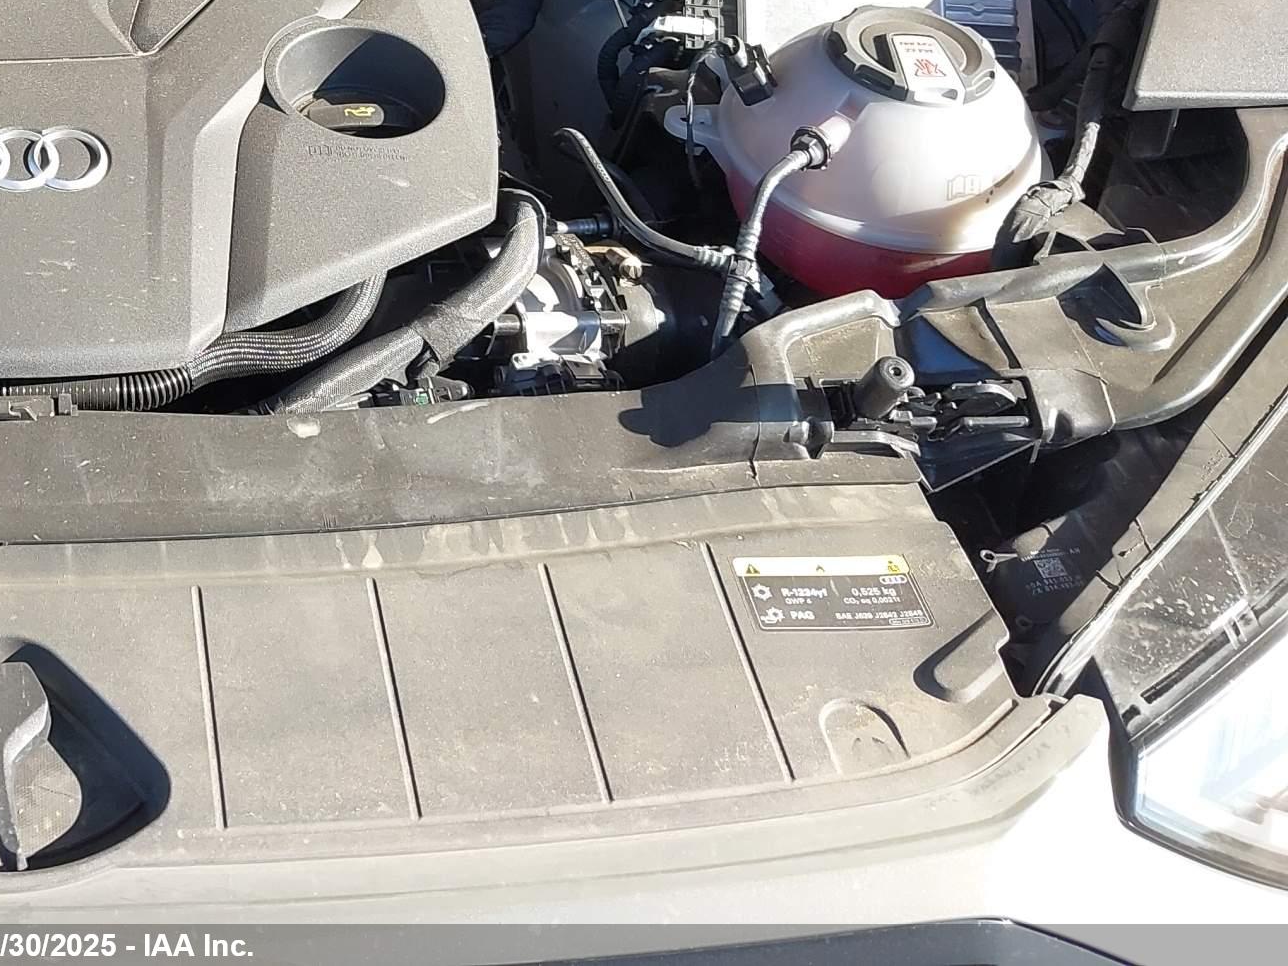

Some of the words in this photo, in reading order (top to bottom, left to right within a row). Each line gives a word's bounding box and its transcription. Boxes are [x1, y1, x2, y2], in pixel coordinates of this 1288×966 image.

[851, 588, 881, 598] 0,525
[882, 587, 896, 598] kg
[789, 611, 815, 620] PAG
